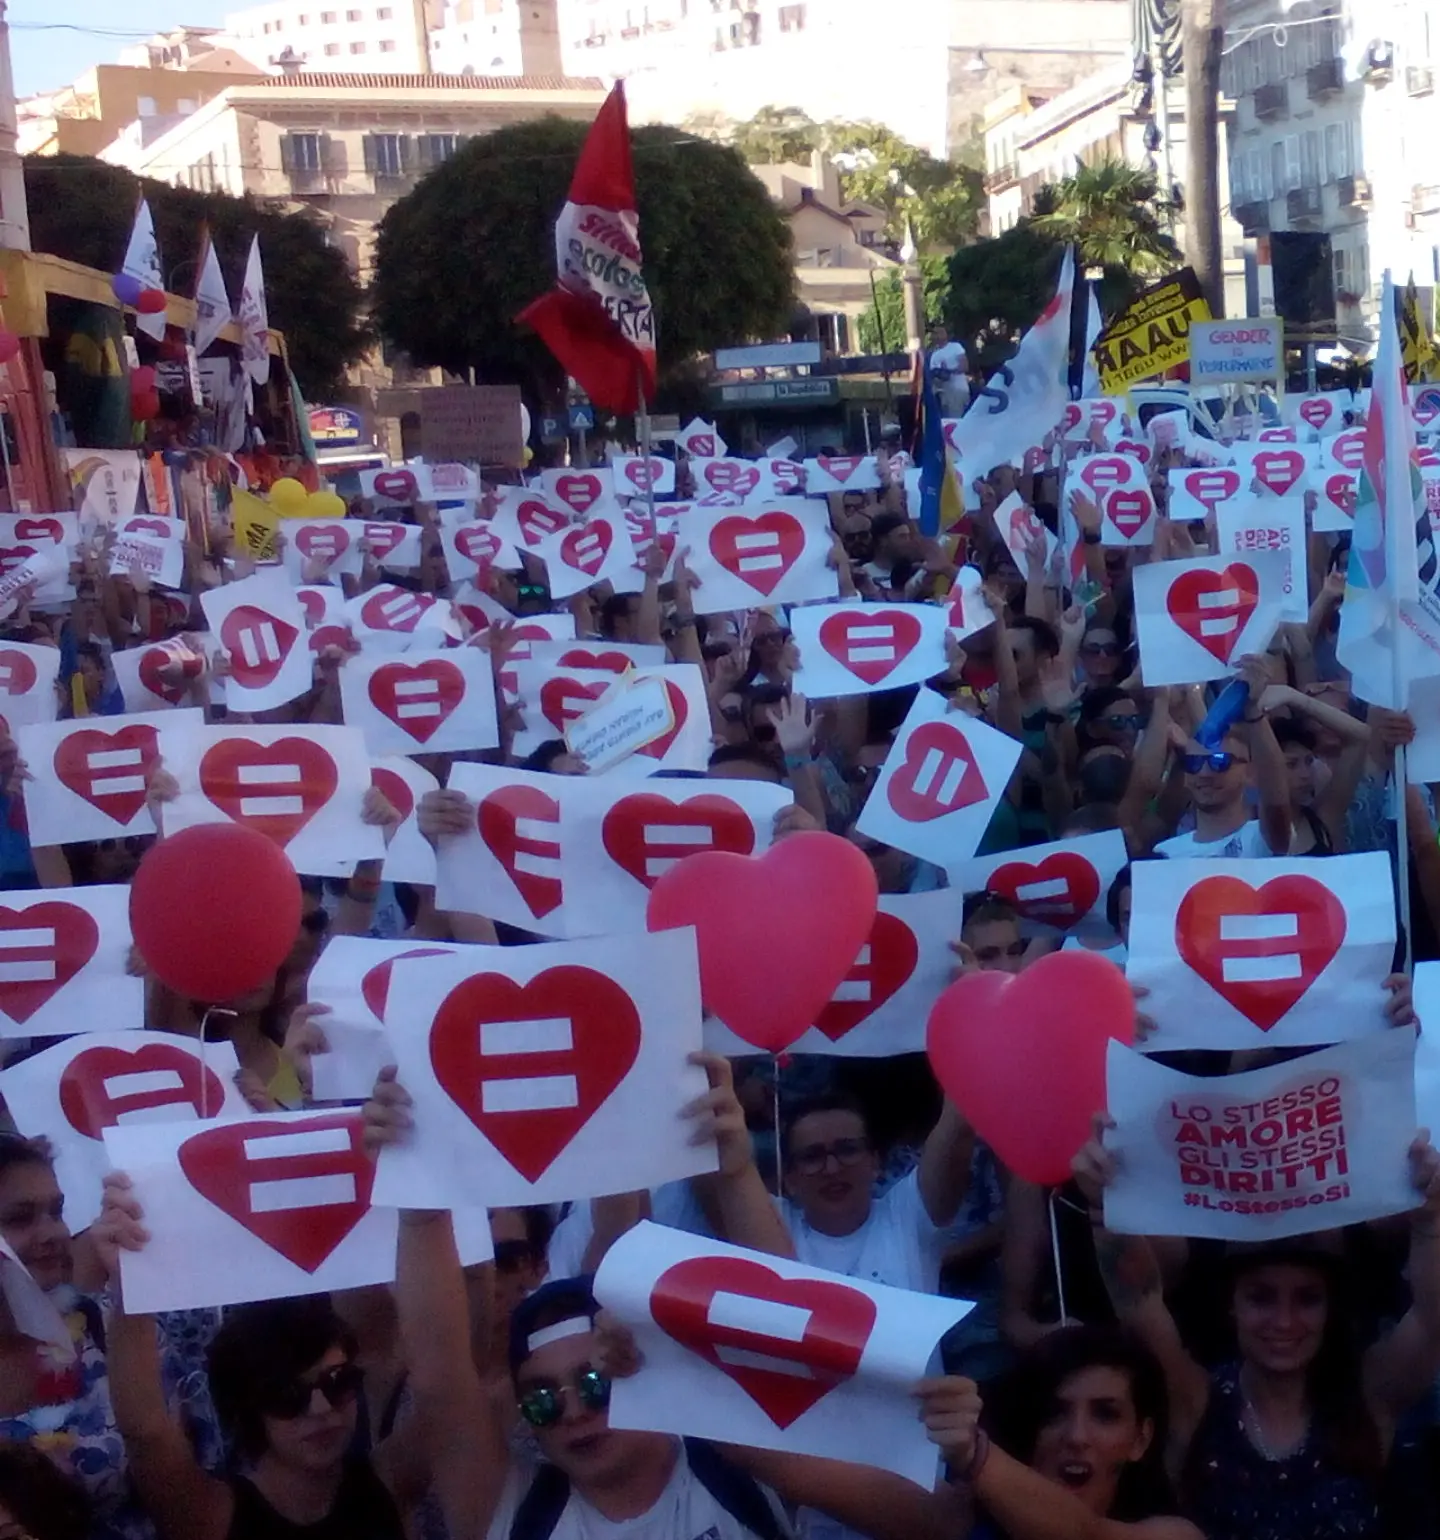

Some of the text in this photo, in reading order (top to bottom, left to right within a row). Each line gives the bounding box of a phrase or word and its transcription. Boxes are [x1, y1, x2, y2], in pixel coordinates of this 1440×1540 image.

[1209, 328, 1271, 345] GENDER
[1171, 1077, 1340, 1125] LO STESSO
[1174, 1095, 1344, 1149] AMORE
[1177, 1124, 1345, 1169] GLI STESSI
[1179, 1148, 1349, 1193] DIRITTI
